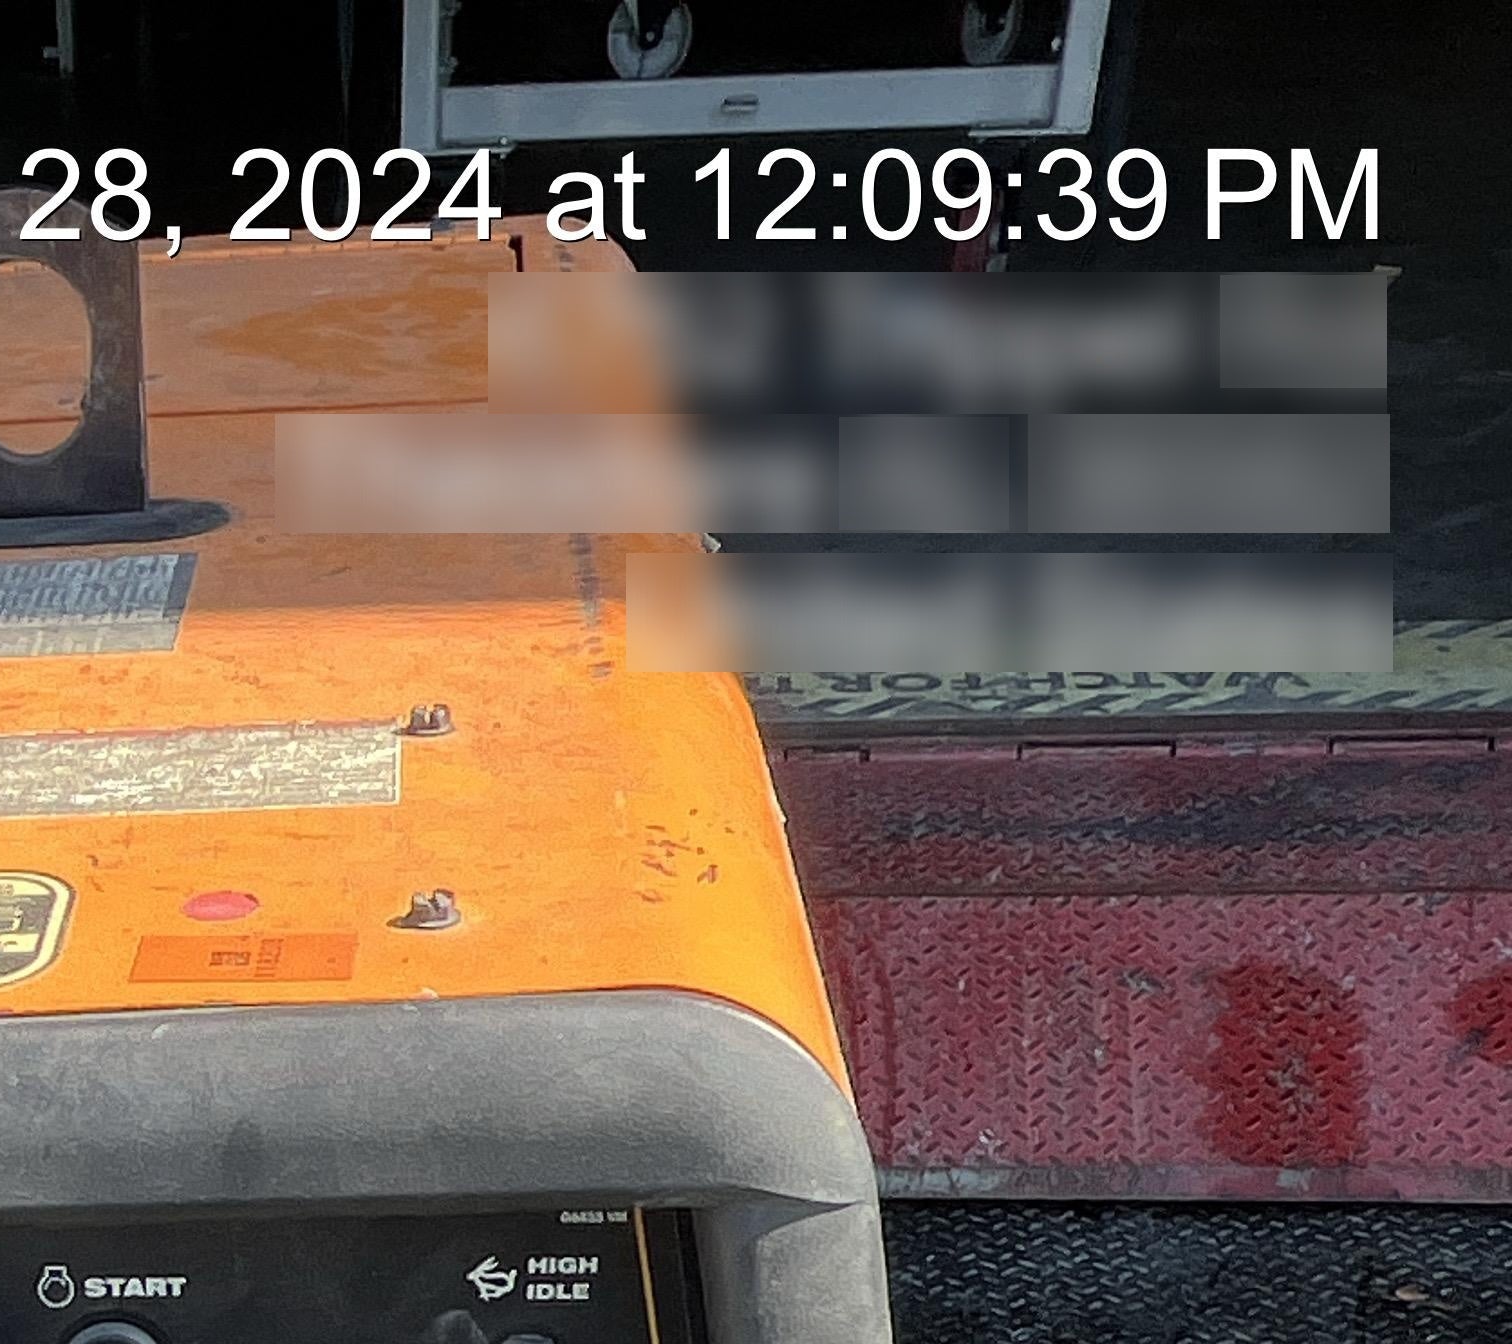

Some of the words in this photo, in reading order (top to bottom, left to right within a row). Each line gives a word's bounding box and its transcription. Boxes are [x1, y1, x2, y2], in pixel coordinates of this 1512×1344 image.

[527, 1256, 599, 1274] HIGH
[84, 1277, 187, 1298] START
[526, 1283, 590, 1300] IDLE
